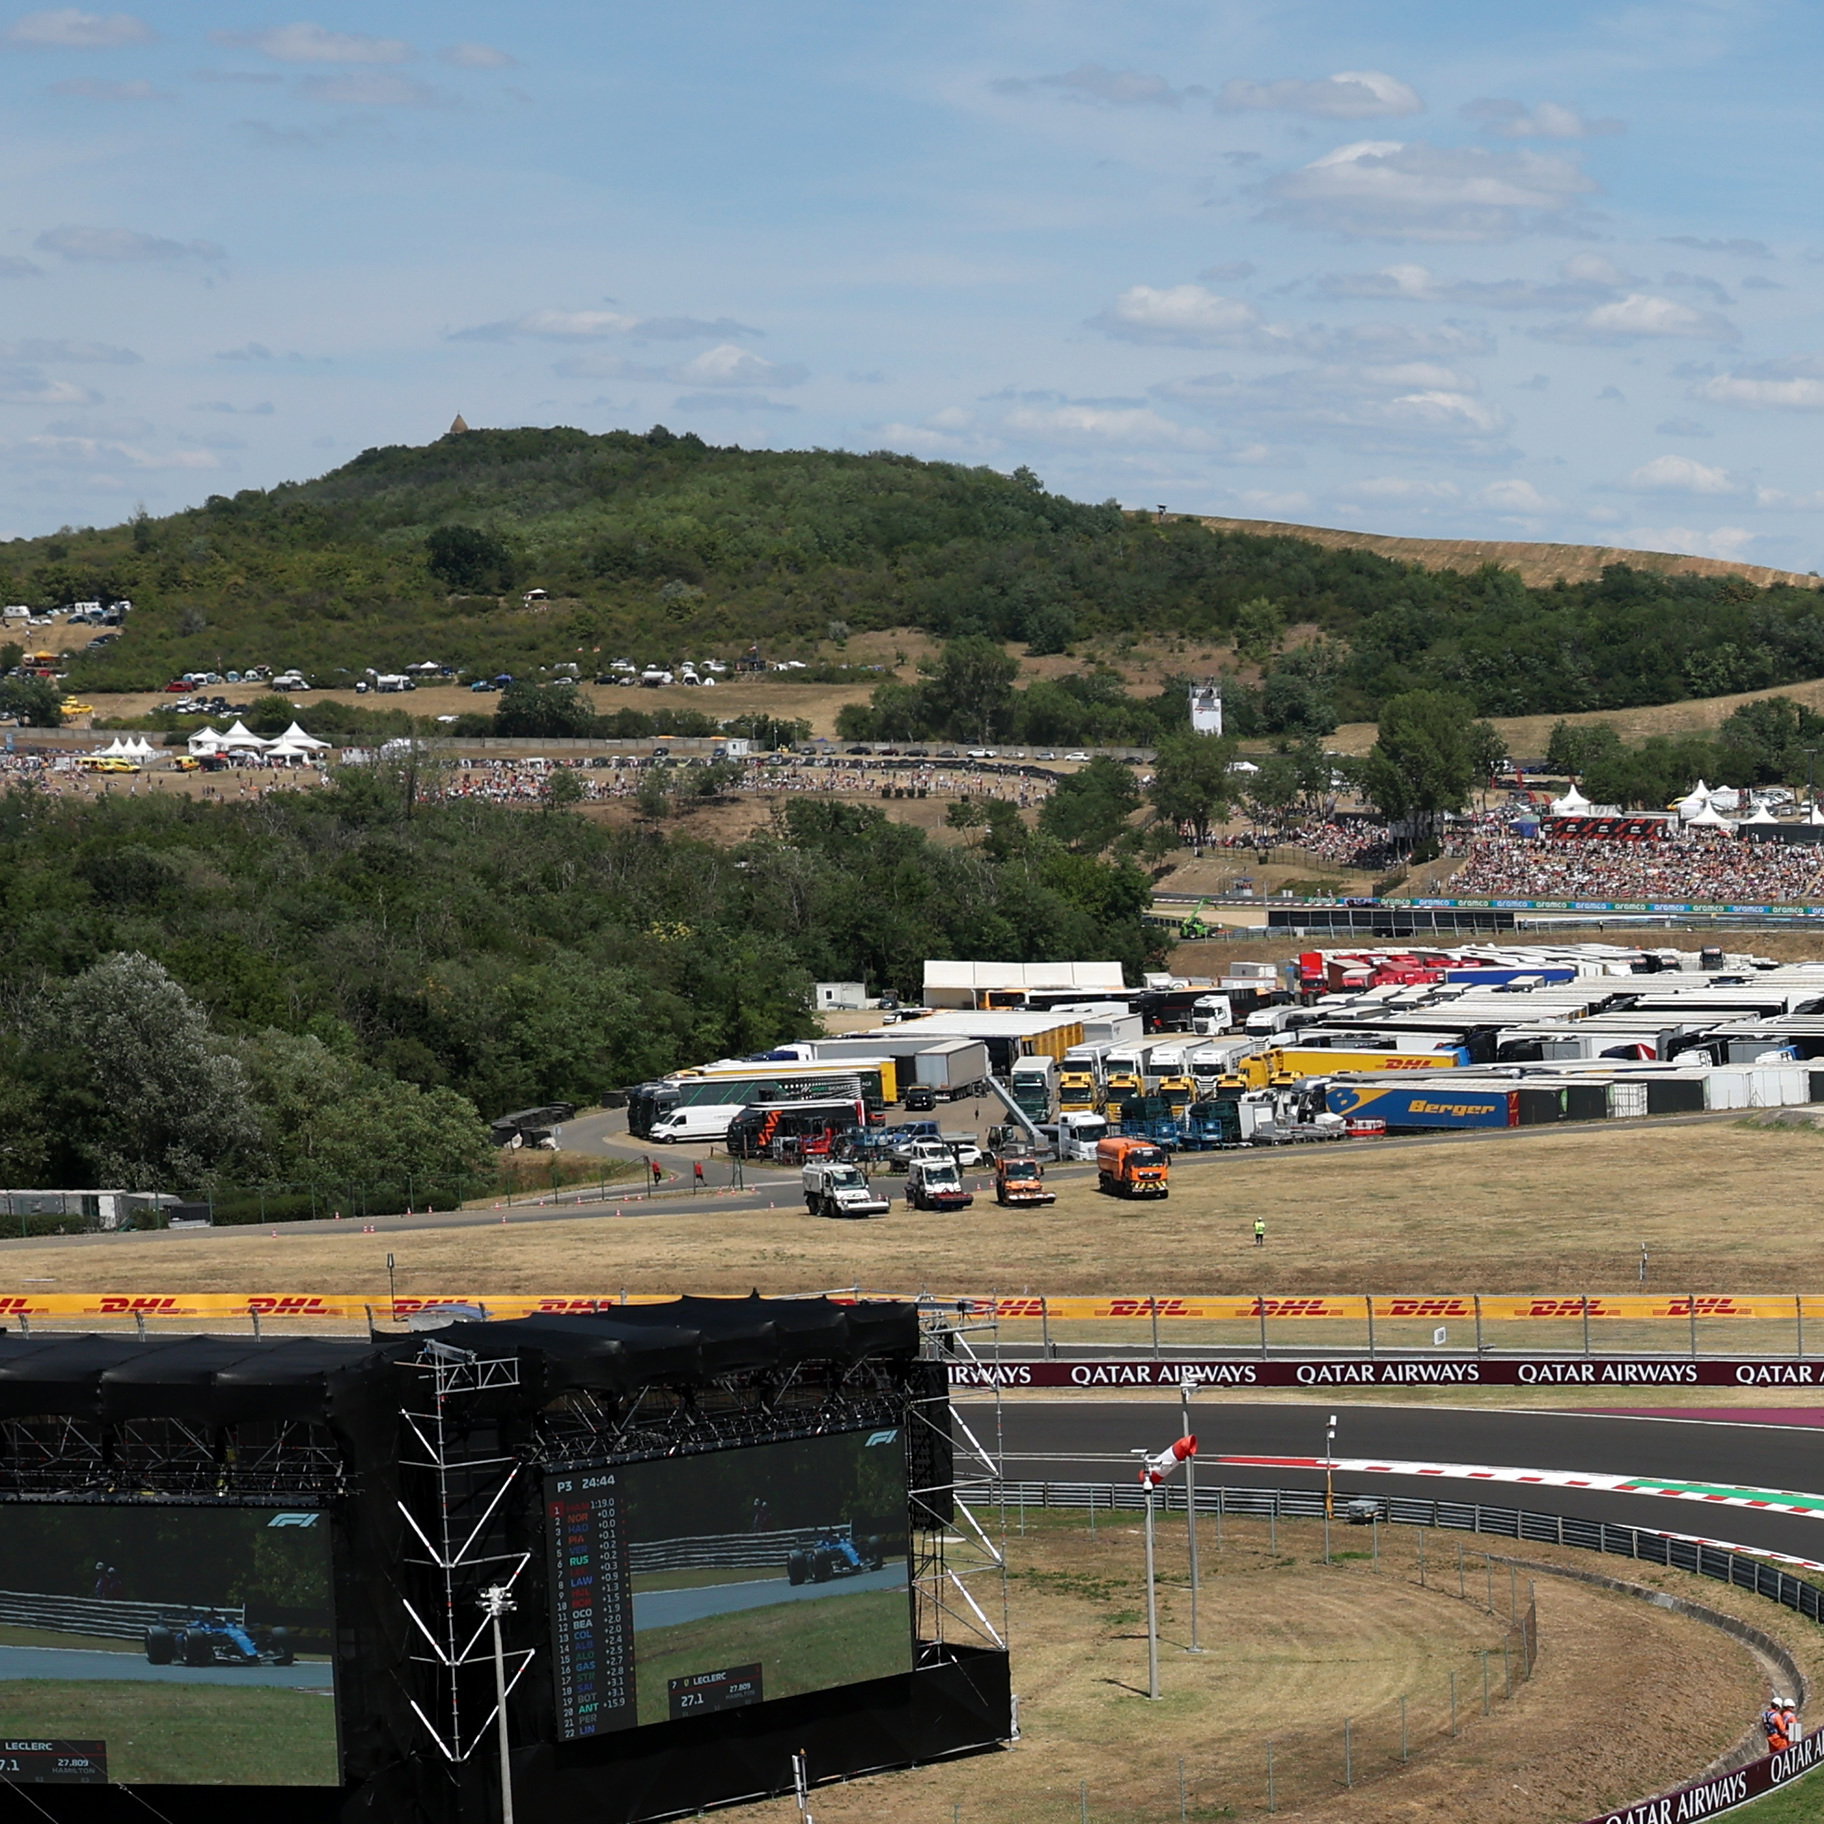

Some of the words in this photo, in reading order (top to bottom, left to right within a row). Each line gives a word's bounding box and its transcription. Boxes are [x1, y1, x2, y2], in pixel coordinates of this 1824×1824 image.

[1385, 1058, 1432, 1070] DHL
[1408, 1100, 1496, 1115] Berger
[100, 1298, 183, 1314] DHL
[1250, 1300, 1329, 1316] DHL
[1390, 1300, 1469, 1315] DHL
[1296, 1365, 1375, 1385] QATAR
[1382, 1365, 1480, 1382] AIRWAYS
[1735, 1366, 1813, 1385] QATAR
[557, 1481, 572, 1493] P3
[582, 1475, 615, 1489] 24:44
[570, 1555, 589, 1565] RUS
[571, 1576, 592, 1587] LAW
[573, 1608, 592, 1618] OCO
[573, 1619, 592, 1630] BEA
[574, 1631, 592, 1640] COL
[576, 1662, 596, 1671] GAS
[693, 1672, 726, 1685] LECLERC
[681, 1693, 704, 1707] 27.1
[578, 1703, 599, 1714] ANT
[5, 1742, 52, 1751] LECLERC
[52, 1767, 95, 1775] HAMILTON
[1676, 1771, 1747, 1823] AIRWAYS
